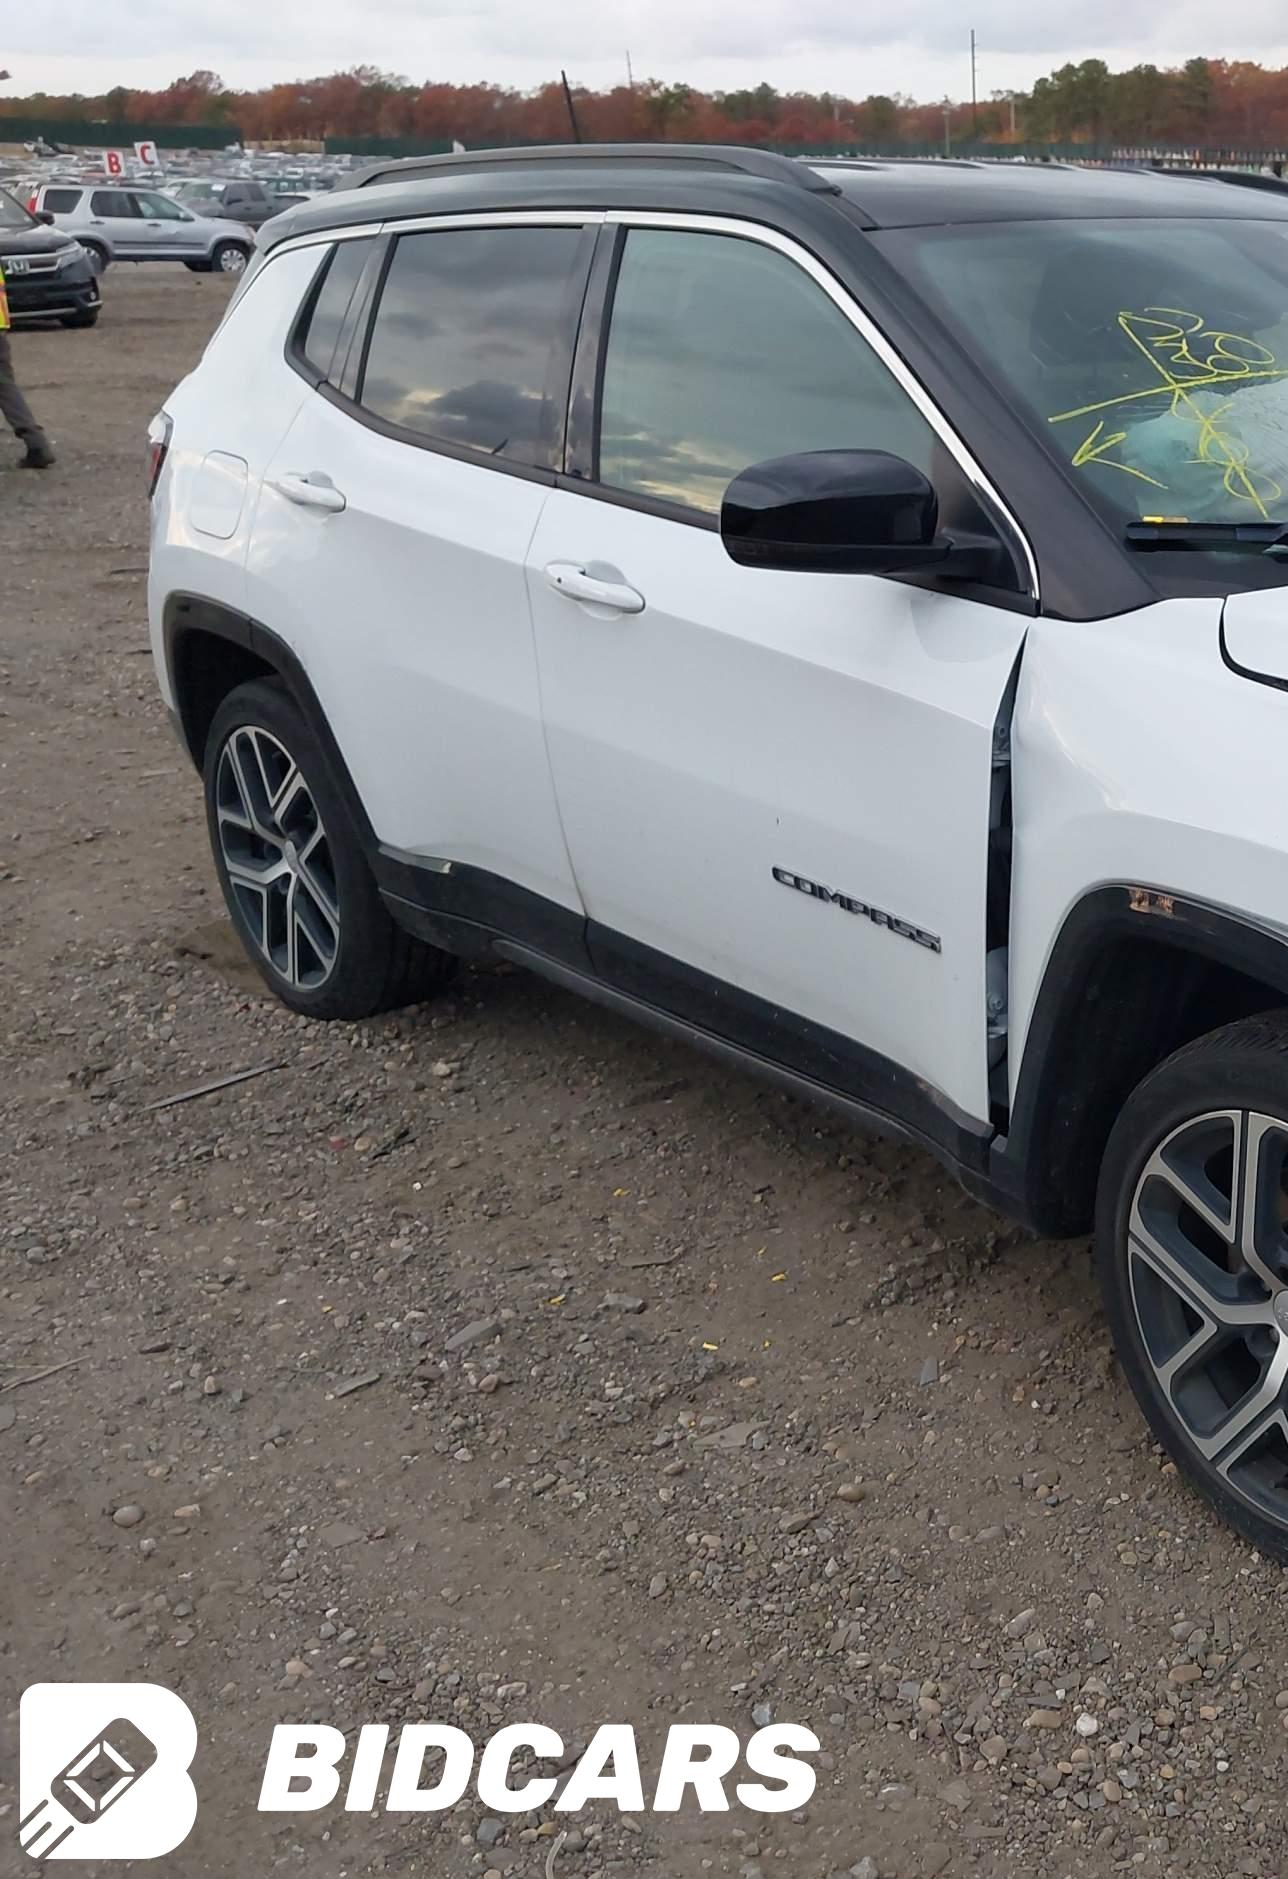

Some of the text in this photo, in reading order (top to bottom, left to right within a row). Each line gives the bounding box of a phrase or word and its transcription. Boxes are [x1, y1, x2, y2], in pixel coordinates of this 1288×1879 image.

[107, 151, 122, 173] B
[140, 144, 155, 165] C
[771, 866, 942, 953] COMPASS
